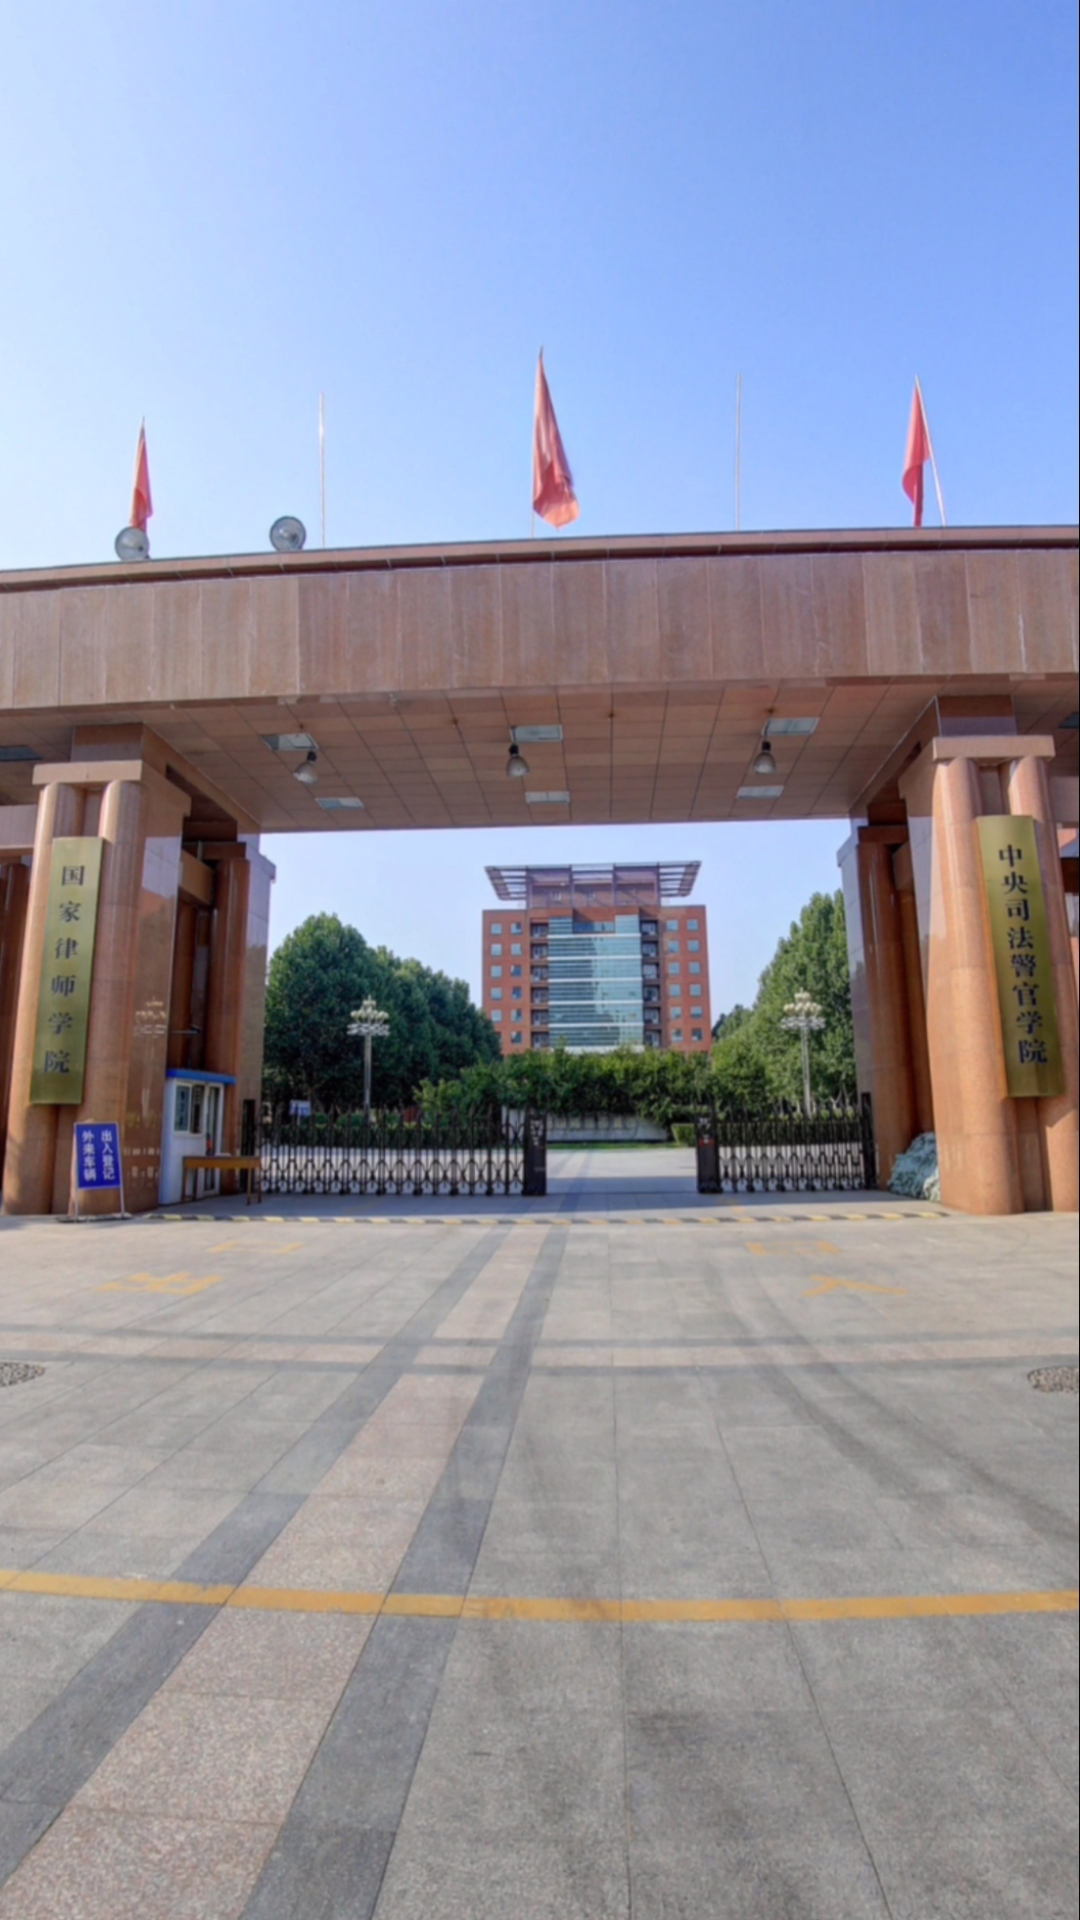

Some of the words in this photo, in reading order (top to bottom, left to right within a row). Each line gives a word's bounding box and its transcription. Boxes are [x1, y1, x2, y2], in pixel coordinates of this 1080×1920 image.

[44, 865, 85, 1074] 国家律师学院
[999, 844, 1048, 1064] 中央司法警官学院
[82, 1130, 97, 1182] 外来车辆
[101, 1130, 116, 1181] 出入登记
